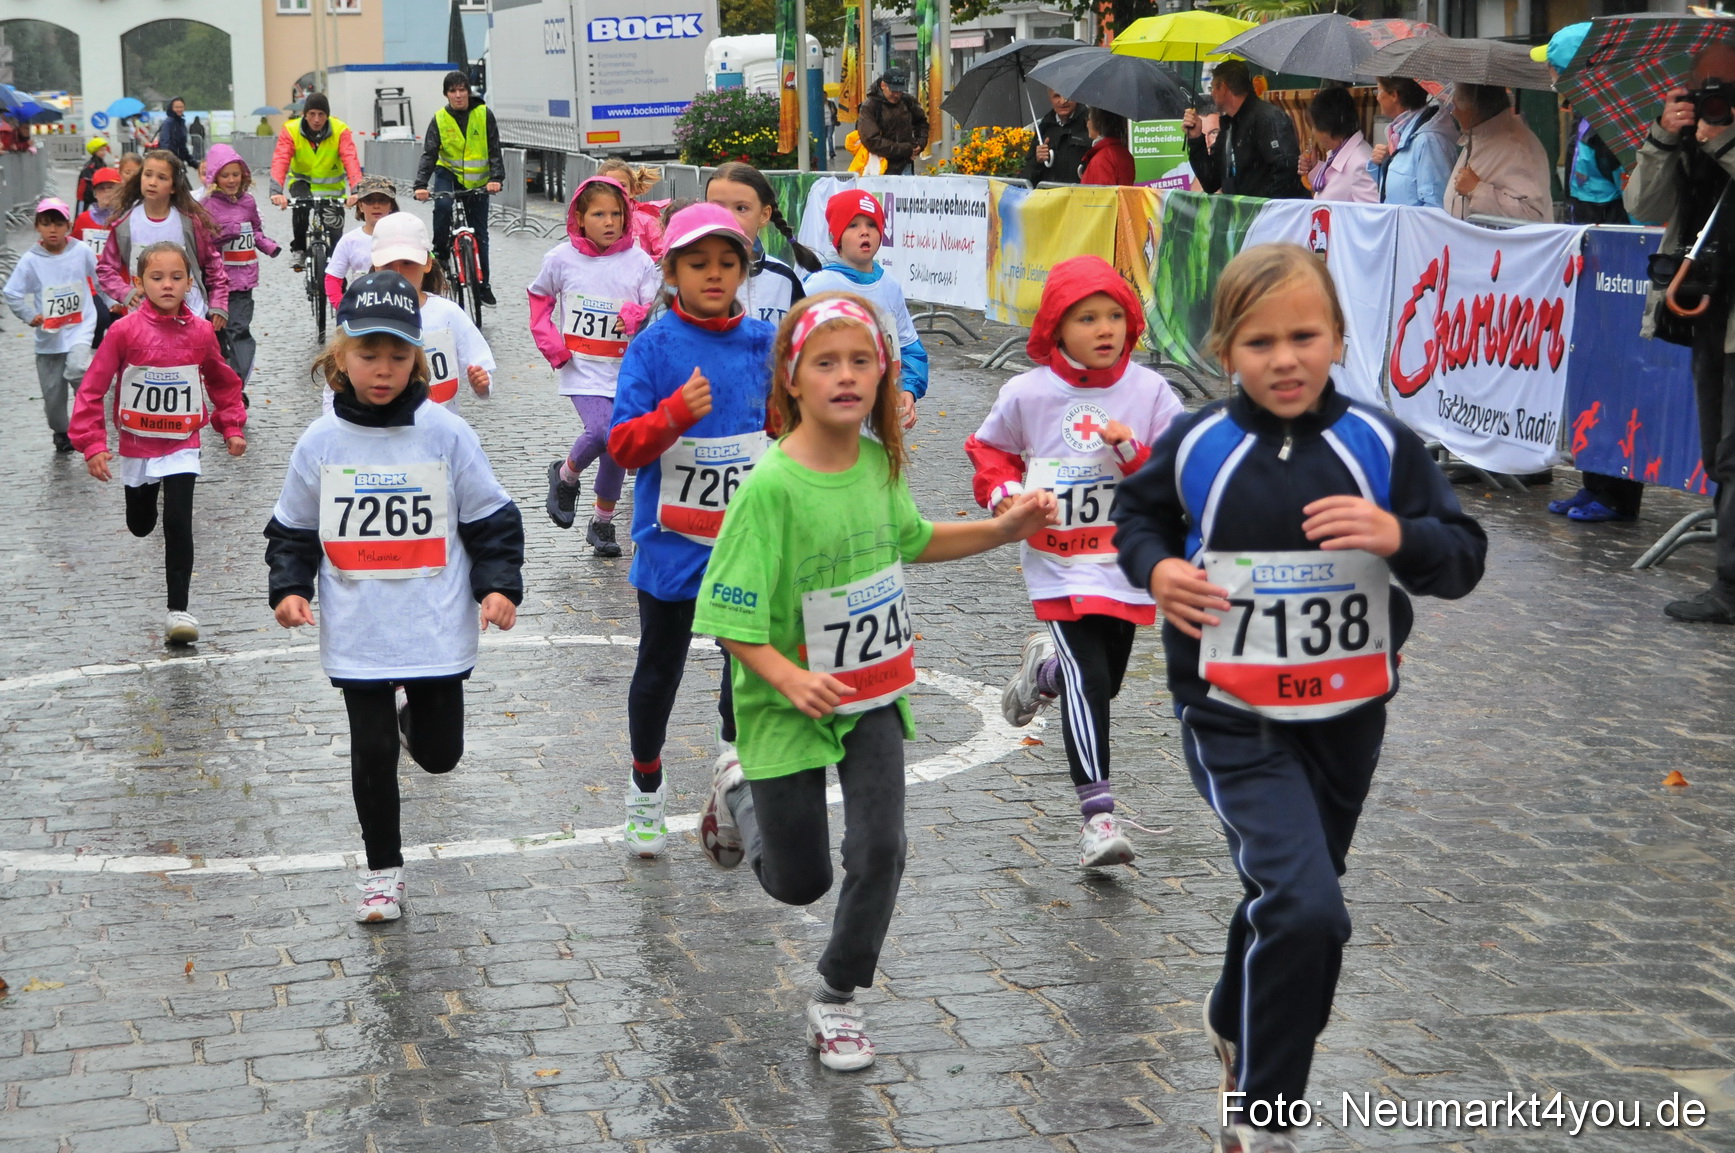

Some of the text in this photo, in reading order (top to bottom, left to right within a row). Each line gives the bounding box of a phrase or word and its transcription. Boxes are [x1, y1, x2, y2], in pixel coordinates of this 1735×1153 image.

[587, 13, 704, 43] BOCK
[1134, 125, 1176, 134] Anpacken.
[1134, 135, 1184, 143] Entscheiden.
[1134, 146, 1160, 154] Lösen.
[1150, 178, 1184, 189] WERNER
[1595, 271, 1634, 294] Masten
[47, 294, 80, 316] 7349
[355, 291, 415, 315] MELANIE
[1390, 244, 1576, 398] Charivari
[144, 371, 180, 381] BOCK
[131, 382, 192, 413] 7001
[140, 416, 182, 431] Nadine
[1065, 404, 1109, 424] DEUTSCHES
[1514, 407, 1557, 446] Radio
[1064, 427, 1083, 450] ROTES
[695, 444, 740, 459] BOCK
[354, 472, 408, 486] BOCK
[1057, 463, 1102, 478] BOCK
[333, 494, 433, 537] 7265
[1043, 483, 1118, 527] 157
[1046, 533, 1099, 552] Daria
[1252, 563, 1335, 583] BOCK
[711, 582, 758, 608] FeBa
[847, 575, 896, 608] BOCK
[823, 594, 912, 669] 7243
[1229, 592, 1370, 659] 7138
[1209, 647, 1218, 659] 3
[1277, 673, 1323, 699] Eva
